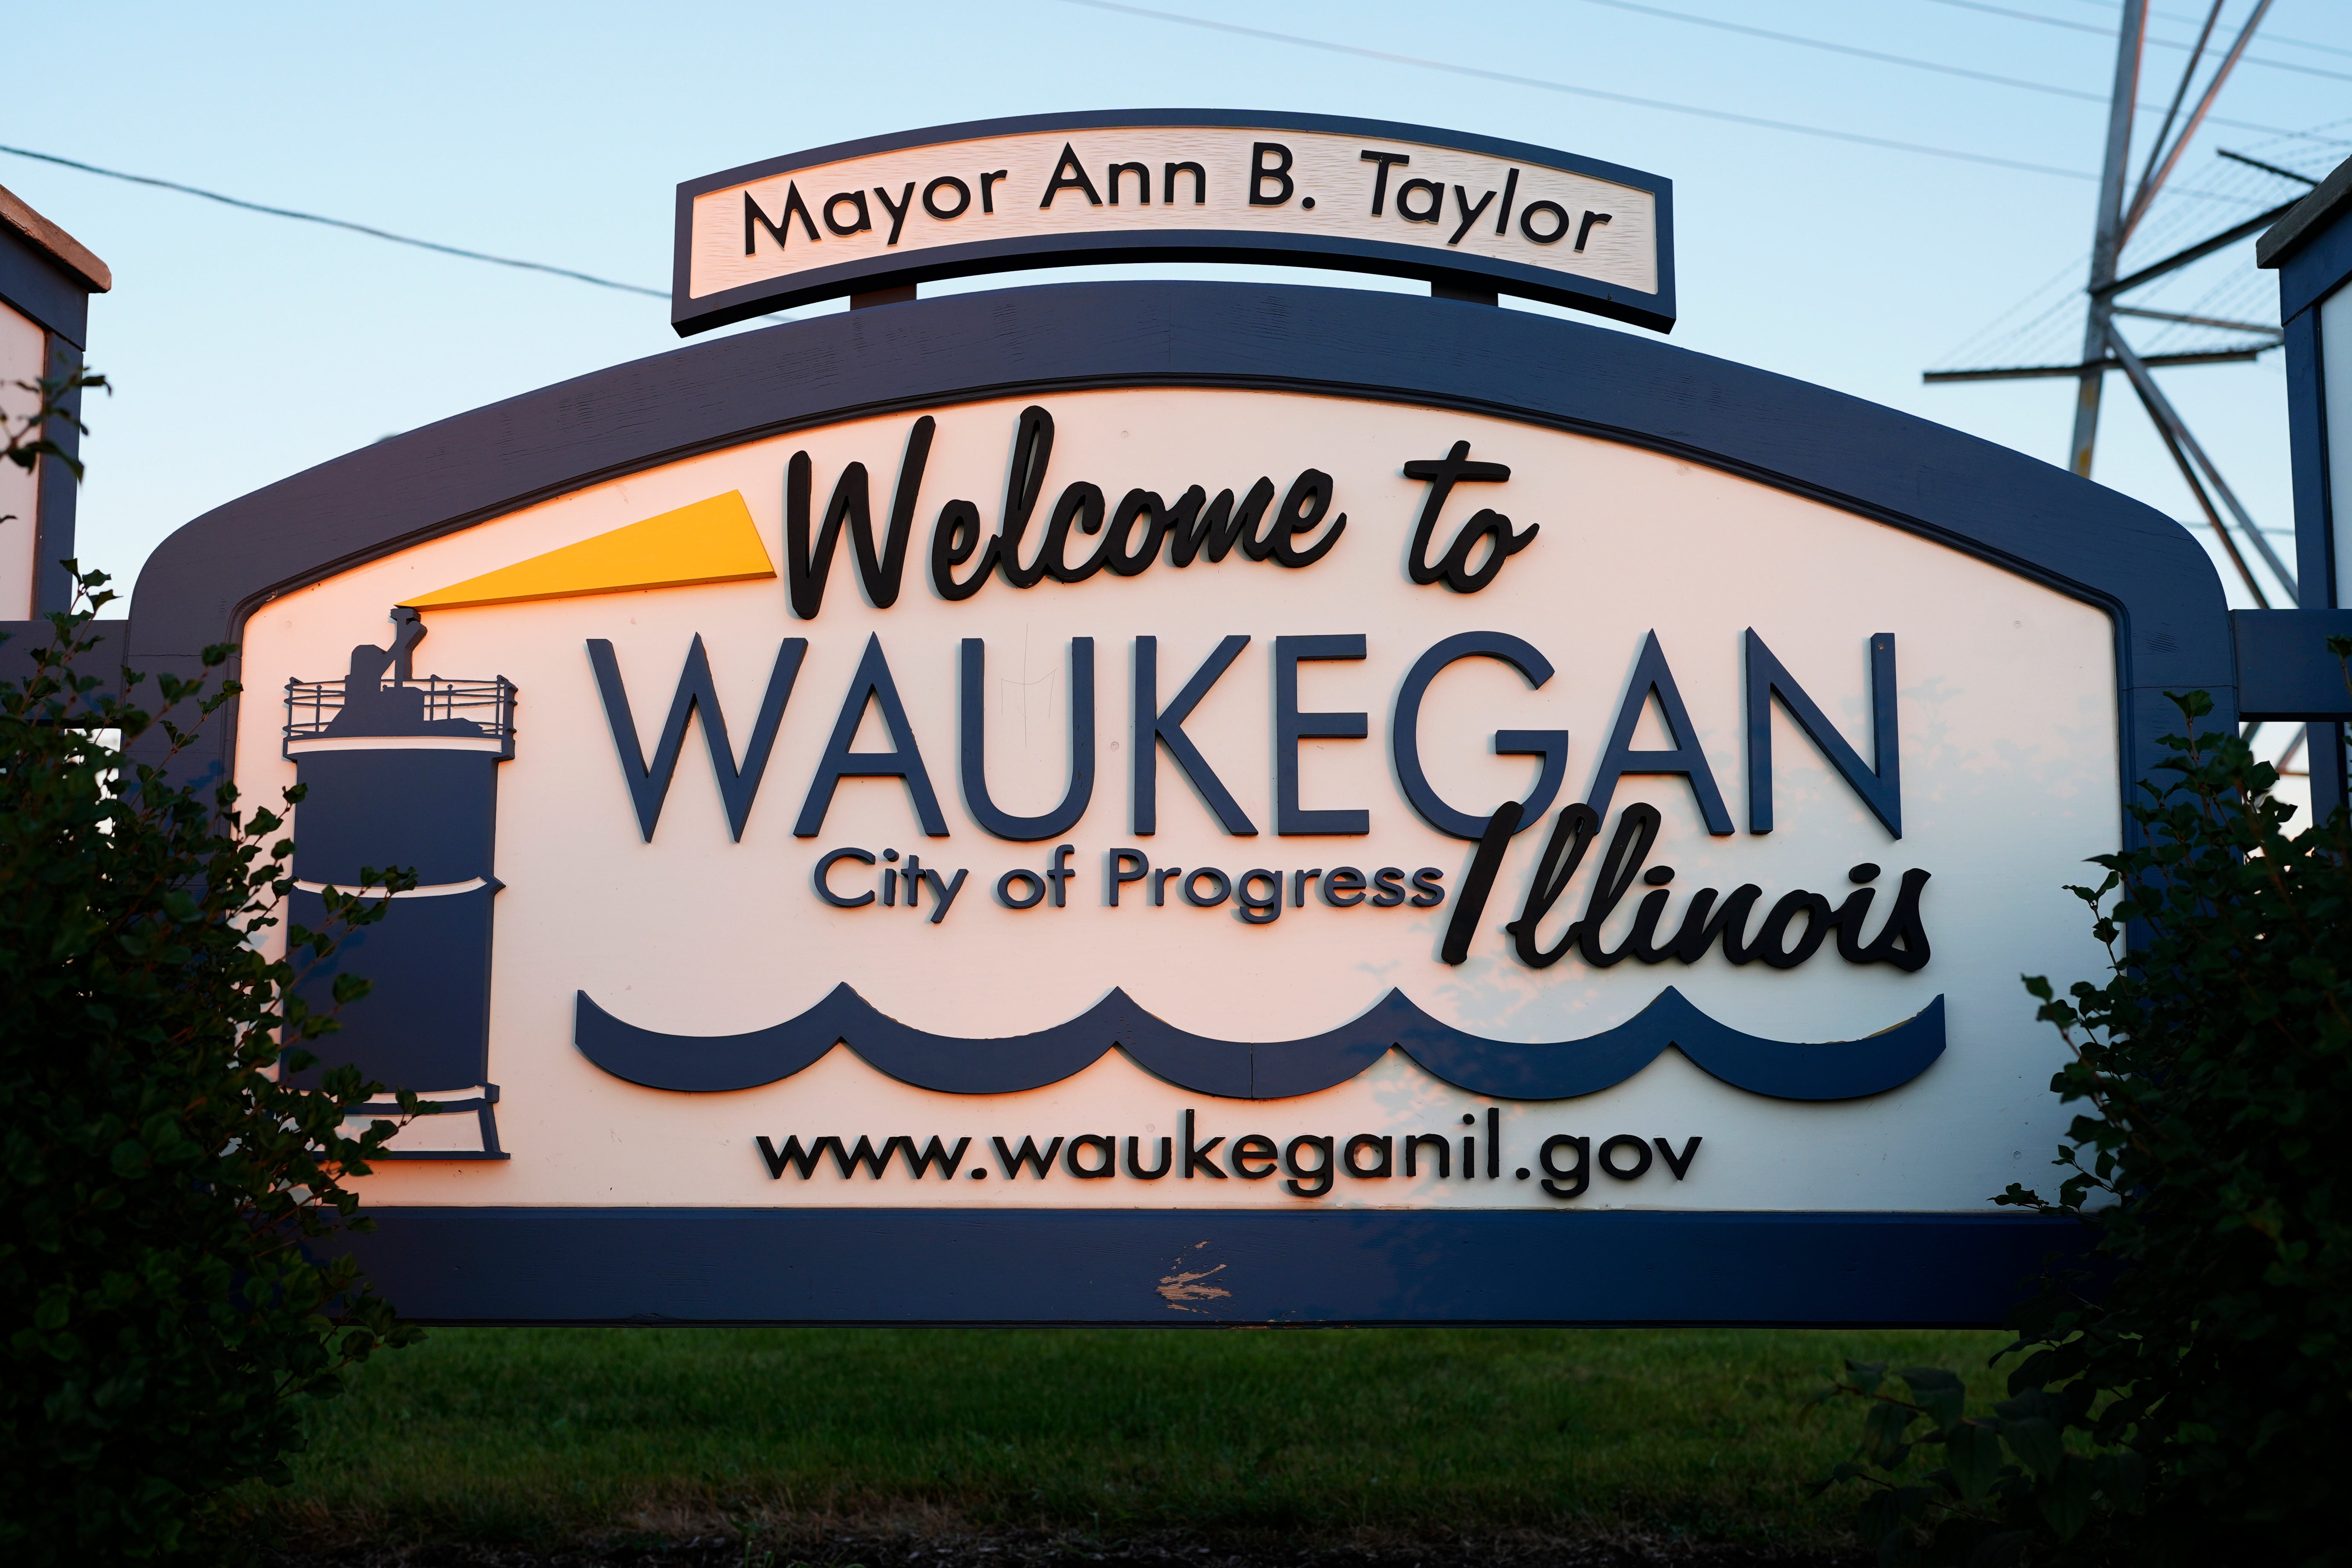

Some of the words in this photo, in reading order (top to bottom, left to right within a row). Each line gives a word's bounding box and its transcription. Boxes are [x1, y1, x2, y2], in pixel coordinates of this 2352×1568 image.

[743, 169, 1007, 257] Mayor
[1040, 142, 1207, 209] Ann
[1249, 142, 1316, 211] B.
[1360, 150, 1613, 252] Taylor
[786, 406, 1347, 619] Welcome
[1404, 440, 1540, 594] to
[586, 628, 1903, 843] WAUKEGAN
[815, 848, 968, 924] City
[997, 845, 1075, 909] of
[1109, 847, 1445, 924] Progress
[1441, 802, 1932, 971] Illinois
[757, 1110, 1702, 1197] www.waukeganil.gov
